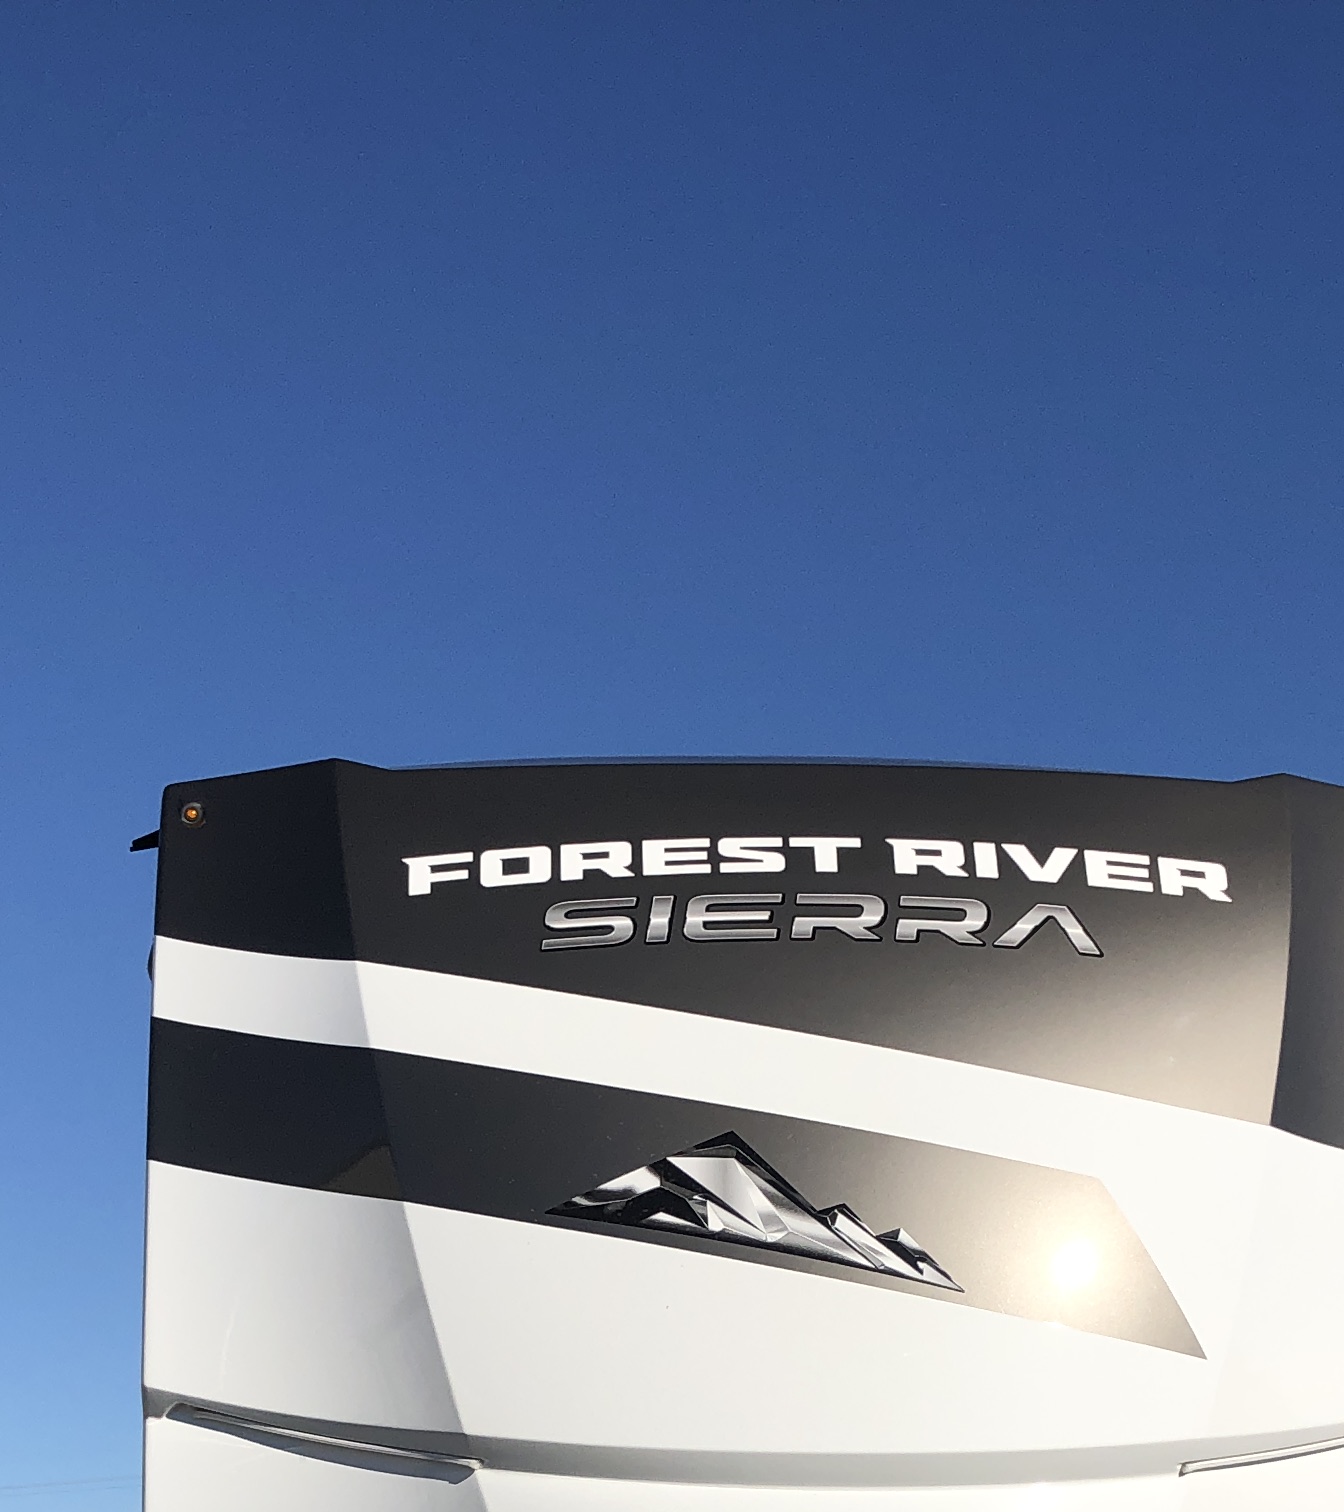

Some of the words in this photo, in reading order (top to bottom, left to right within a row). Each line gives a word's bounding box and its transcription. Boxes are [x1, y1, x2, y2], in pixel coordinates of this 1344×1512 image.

[401, 837, 862, 896] FOREST
[884, 838, 1233, 903] RIVER
[540, 893, 1104, 957] SIERRA
